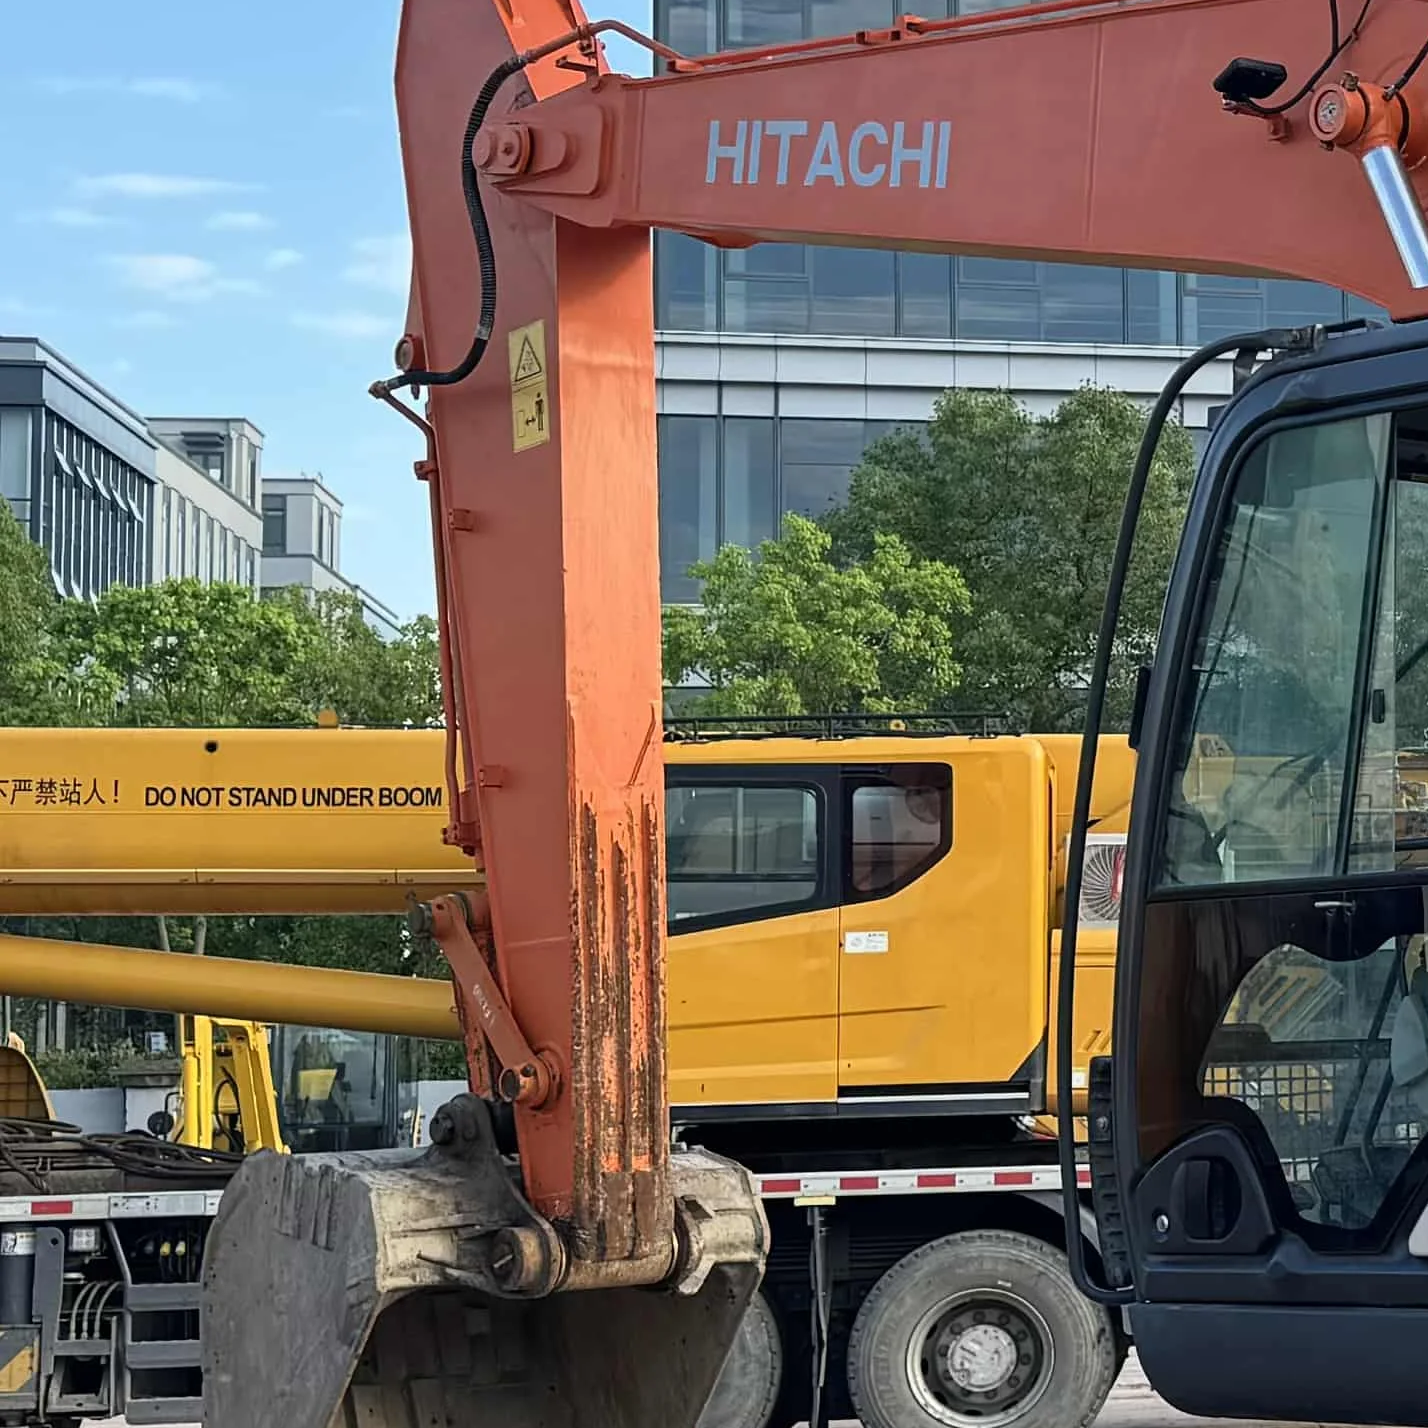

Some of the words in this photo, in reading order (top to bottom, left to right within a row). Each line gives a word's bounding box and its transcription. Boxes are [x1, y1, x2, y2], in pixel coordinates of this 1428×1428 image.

[705, 119, 952, 189] HITACHI
[145, 786, 177, 807] DO
[181, 786, 225, 807] NOT
[228, 786, 297, 807] STAND
[302, 786, 373, 807] UNDER
[379, 786, 442, 807] BOOM
